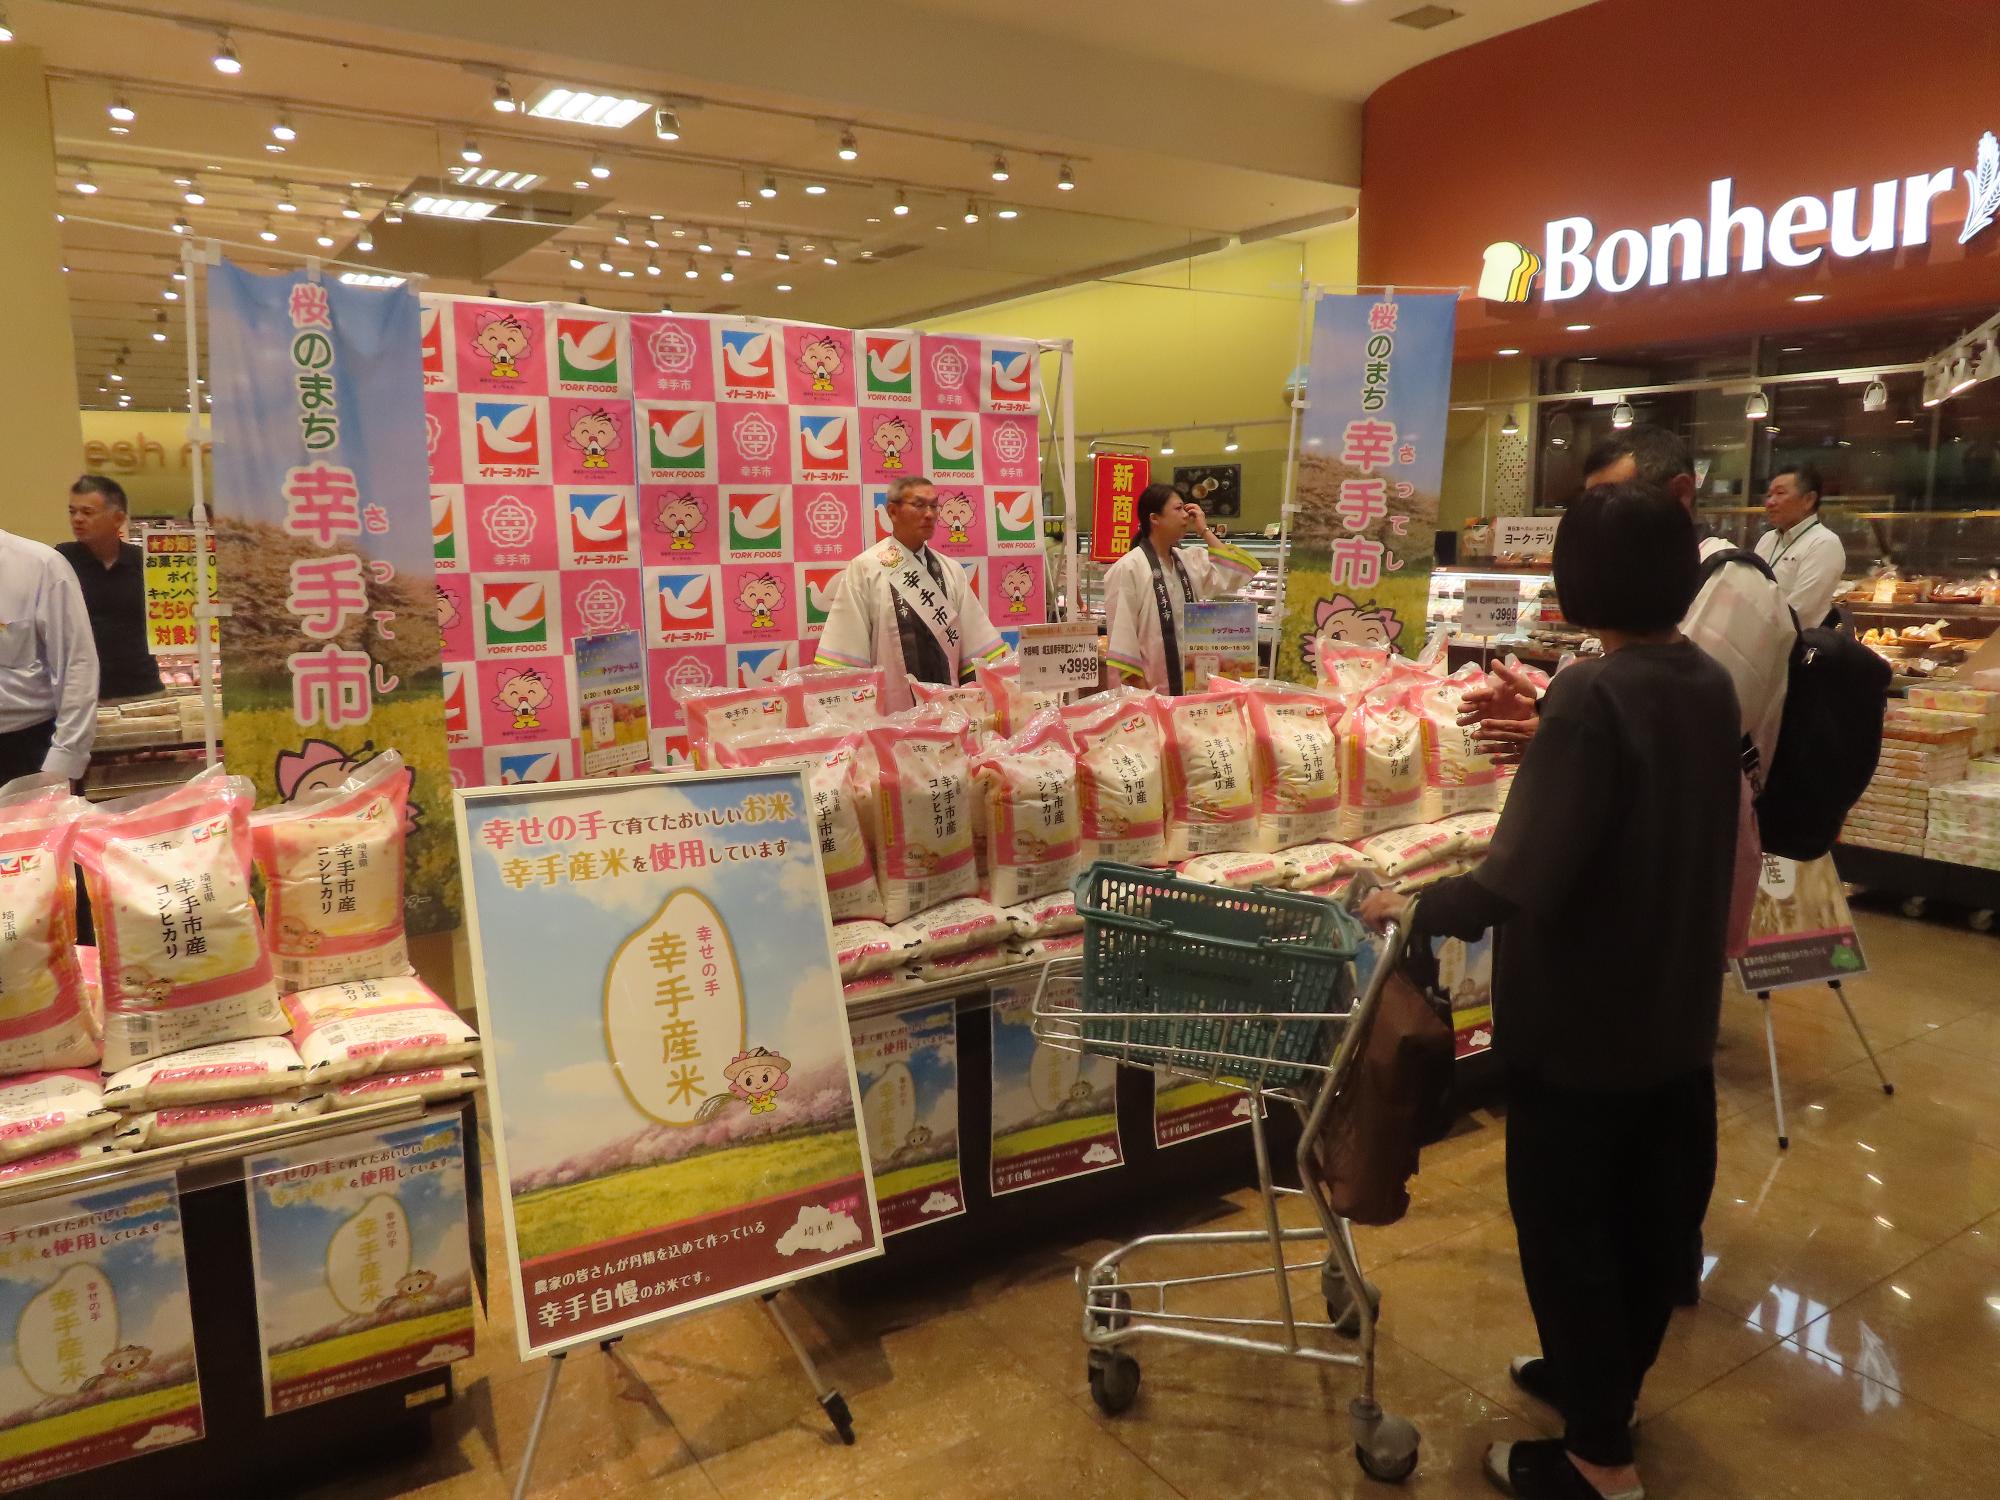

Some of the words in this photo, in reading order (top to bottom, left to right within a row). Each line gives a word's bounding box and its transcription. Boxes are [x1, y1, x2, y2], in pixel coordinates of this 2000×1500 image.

[1543, 167, 1954, 301] Bonheur
[289, 284, 338, 450] 桜のまち
[1363, 303, 1398, 410] 桜のまち
[560, 384, 584, 393] YORK
[586, 384, 618, 393] FOODS
[867, 393, 886, 402] YORK
[888, 394, 912, 402] FOODS
[651, 470, 674, 478] YORK
[675, 470, 705, 478] FOODS
[1331, 421, 1396, 588] 幸手市
[1111, 463, 1135, 553] 新商品
[730, 550, 753, 559] YORK
[755, 551, 782, 559] FOODS
[289, 464, 371, 728] 幸手市
[902, 570, 960, 647] 幸手市長
[488, 646, 513, 655] YORK
[515, 643, 547, 653] FOODS
[1059, 657, 1097, 673] ¥3998
[1205, 739, 1222, 791] コシヒカリ
[1214, 738, 1236, 790] 幸手市産
[1305, 733, 1325, 782] 幸手市産
[482, 793, 795, 850] 幸せの手で育てたおいしいお米
[815, 792, 836, 854] 幸手市産
[929, 778, 943, 839] コシヒカリ
[941, 776, 956, 836] 幸手市産
[317, 846, 334, 915] コシヒカリ
[336, 842, 356, 913] 幸手市産
[503, 839, 789, 889] 幸手産米を使用しています
[156, 884, 177, 960] コシヒカリ
[175, 878, 208, 957] 幸手市産
[696, 926, 721, 997] 幸せの手
[648, 931, 707, 1106] 幸手産米
[534, 1221, 766, 1295] 農家の皆さんが丹精を込めて作っている
[537, 1271, 711, 1328] 幸手自慢のお米です。
